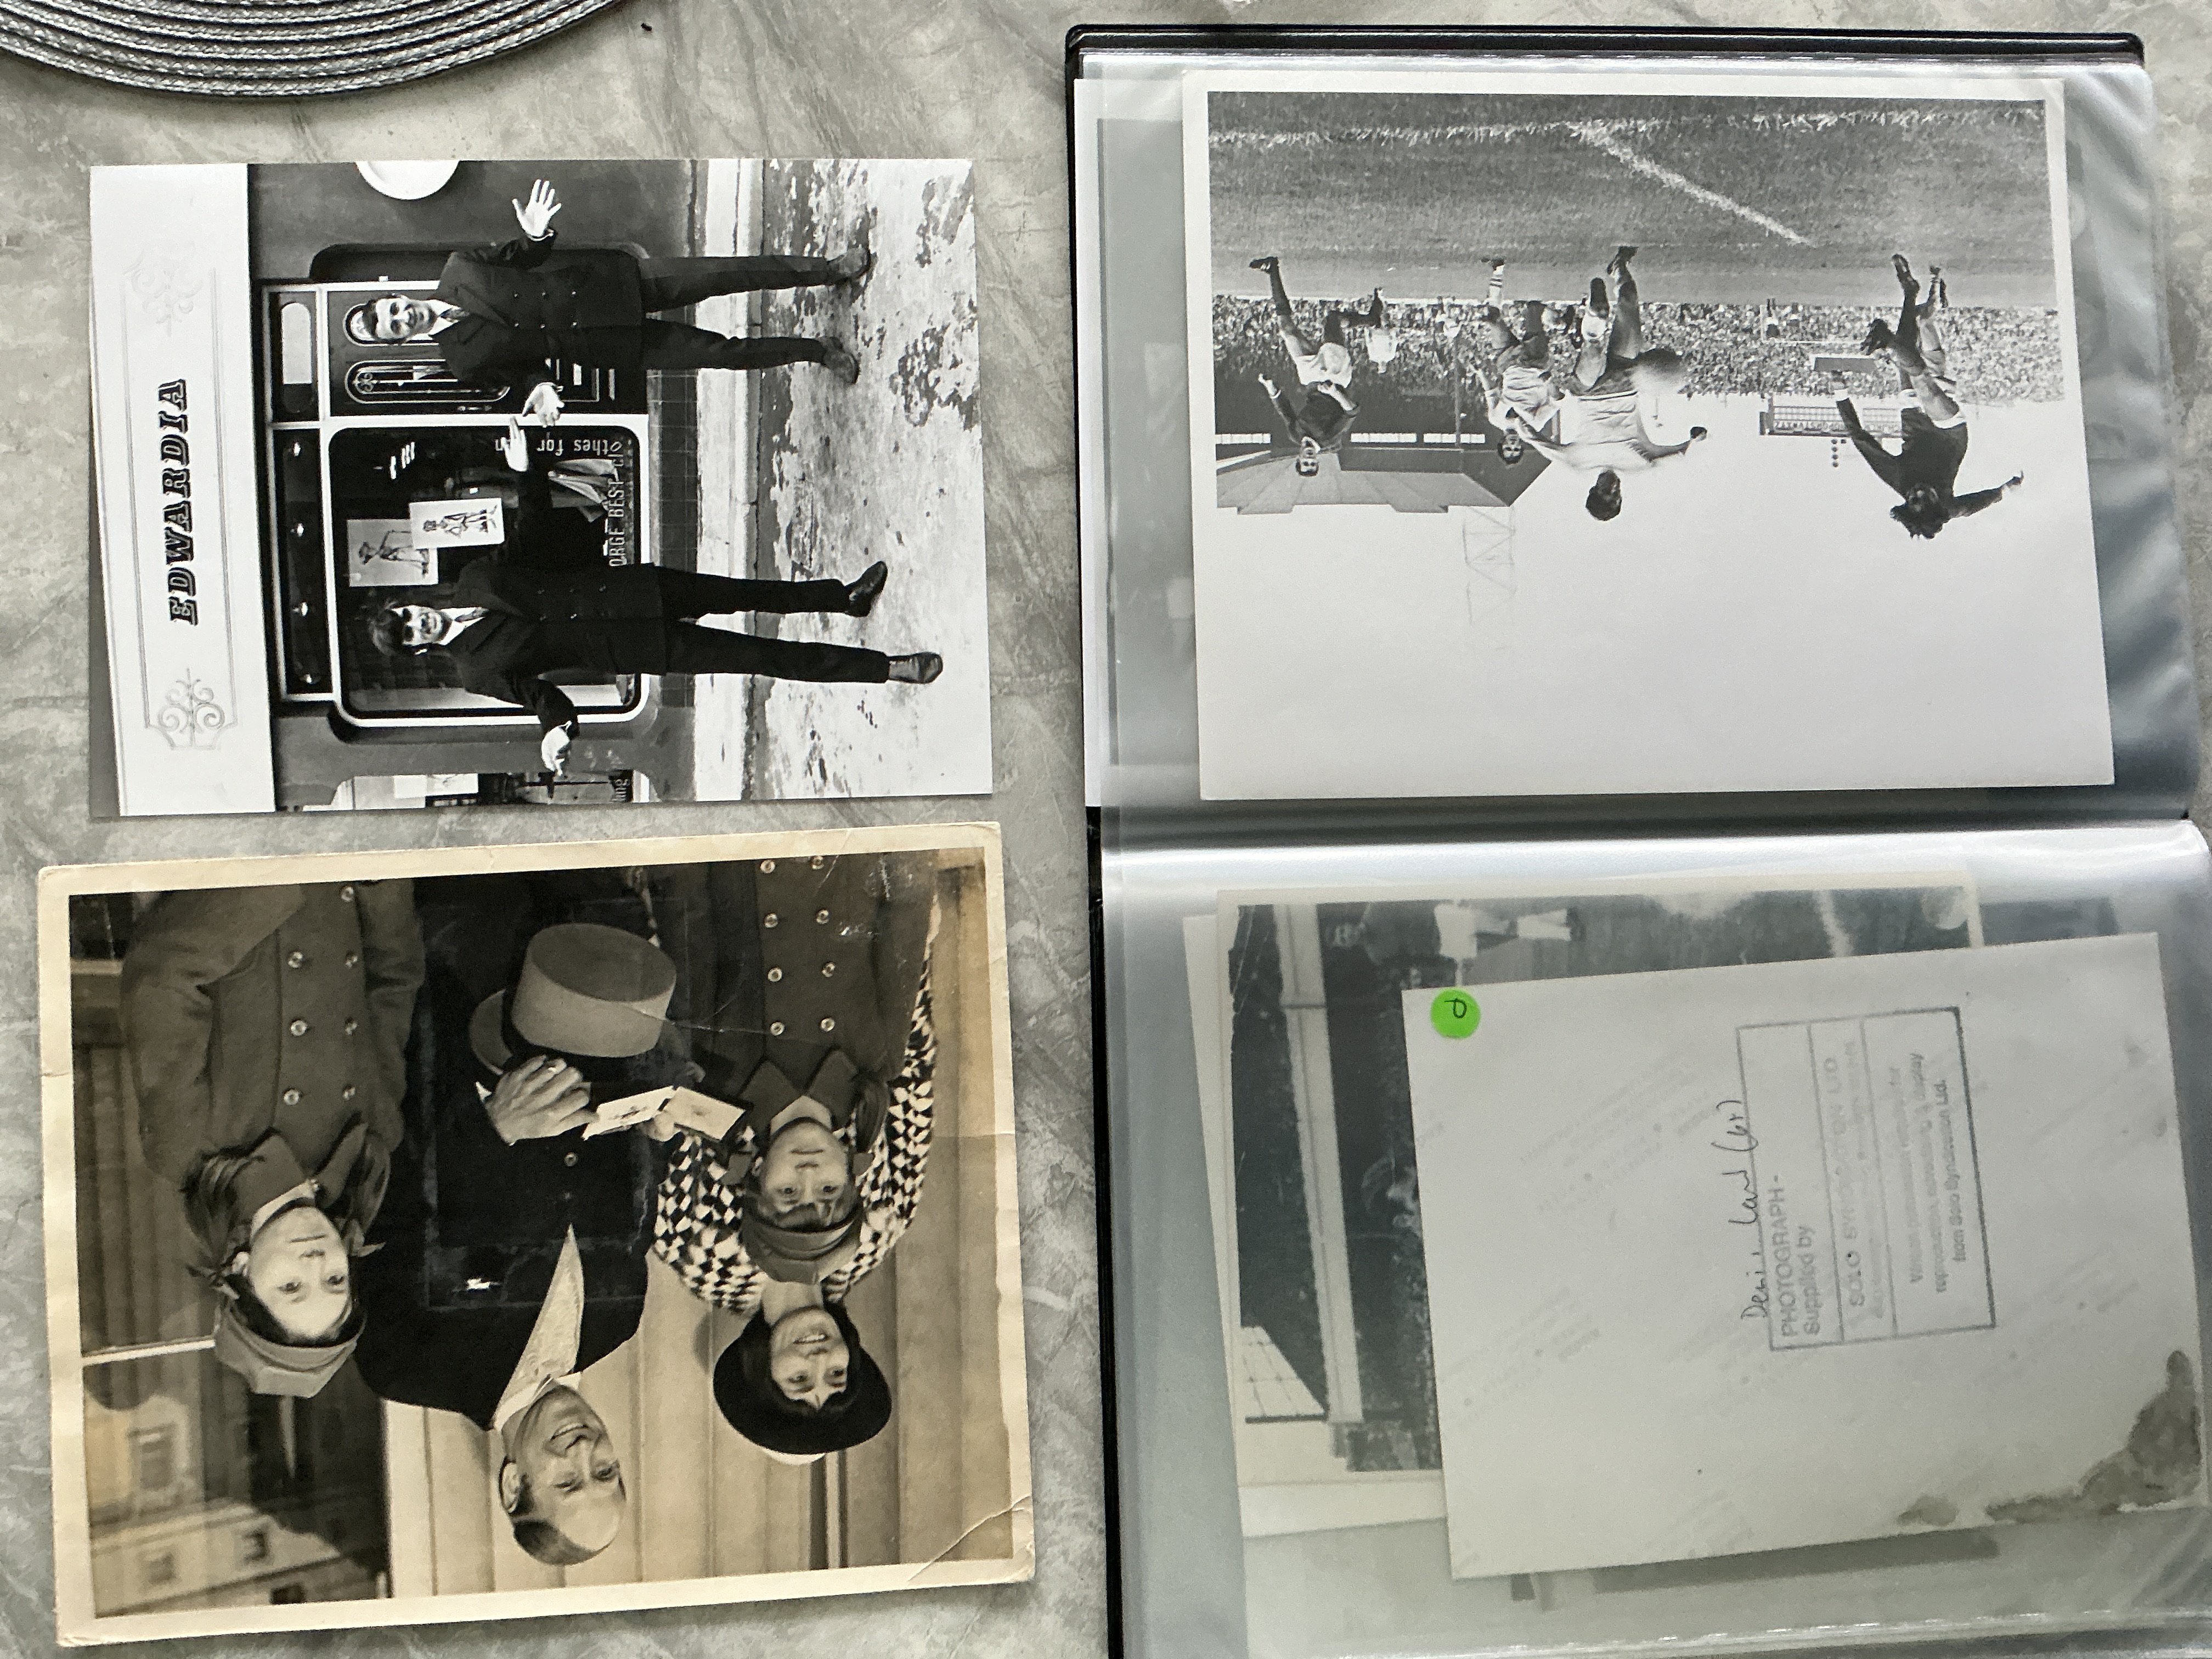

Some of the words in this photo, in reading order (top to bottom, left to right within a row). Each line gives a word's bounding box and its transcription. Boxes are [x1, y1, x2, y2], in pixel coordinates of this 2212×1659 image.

[535, 439, 564, 456] for
[158, 379, 198, 626] EDWARDIA
[607, 479, 625, 517] BEST
[1797, 1225, 1815, 1248] by
